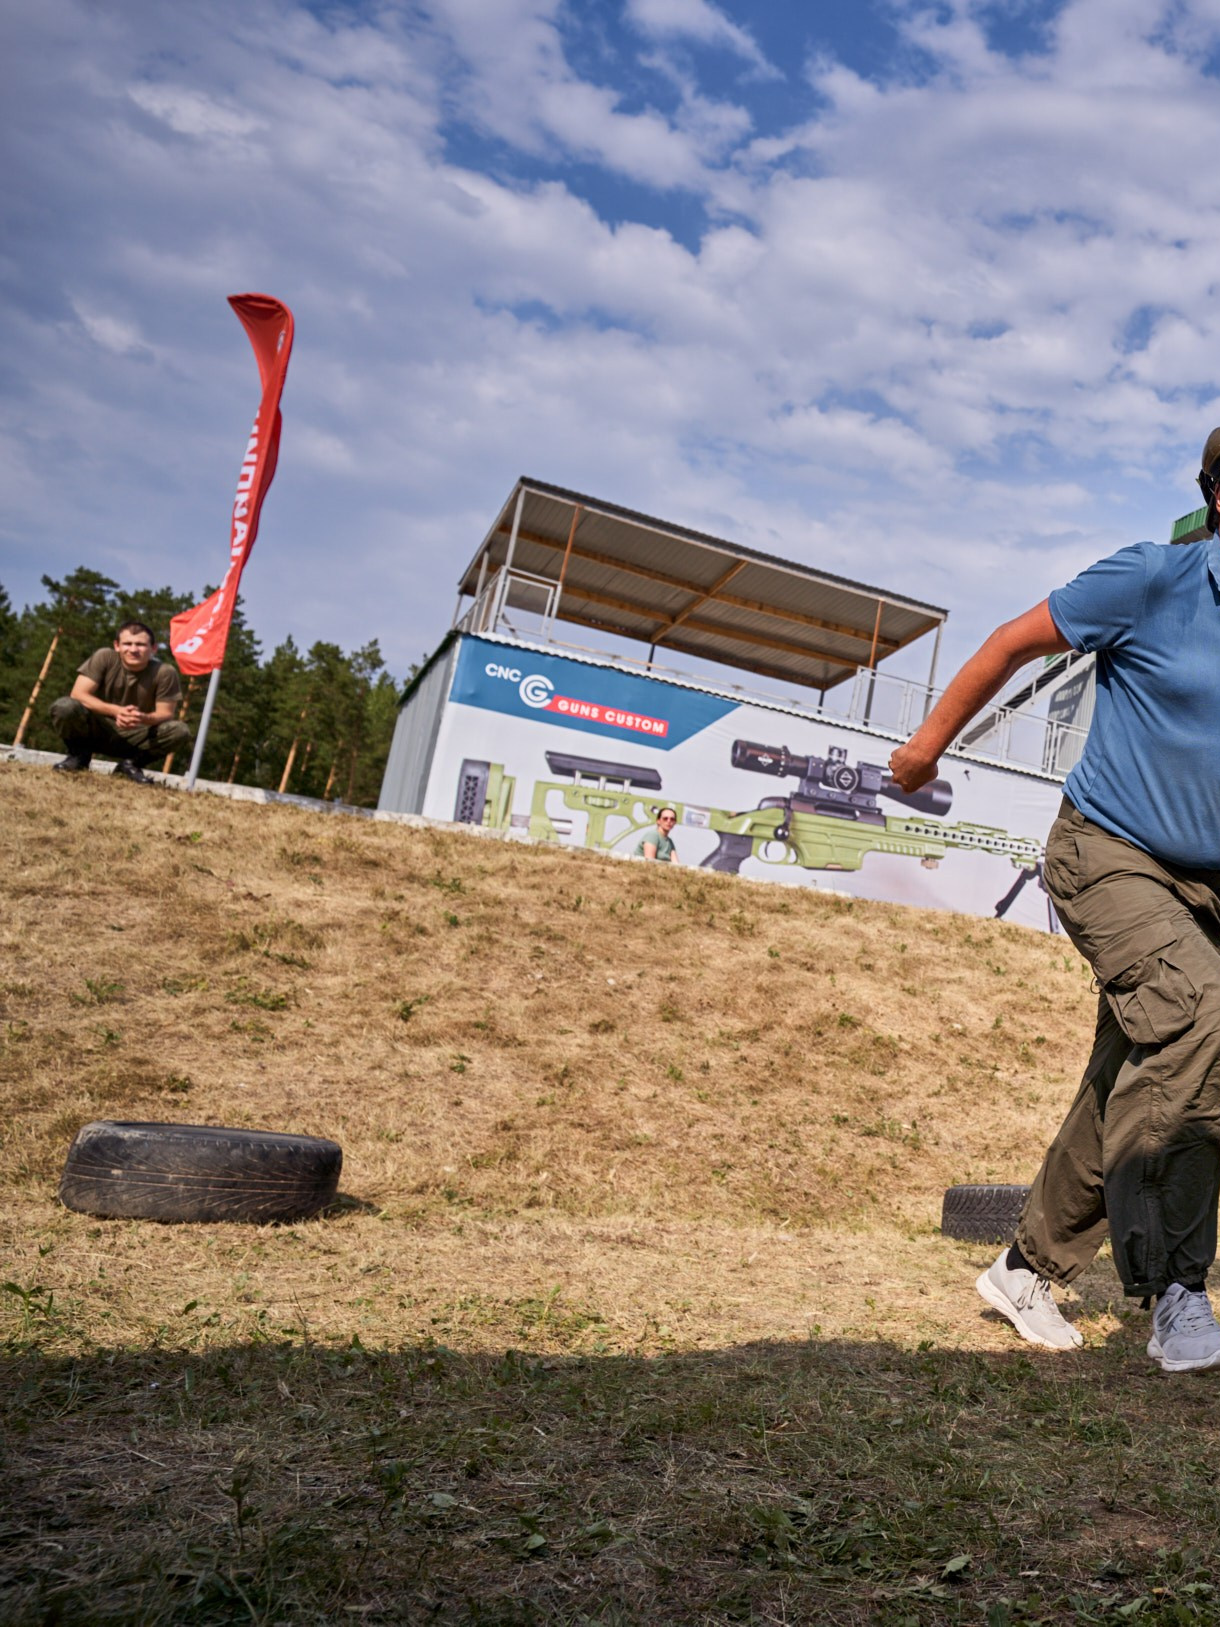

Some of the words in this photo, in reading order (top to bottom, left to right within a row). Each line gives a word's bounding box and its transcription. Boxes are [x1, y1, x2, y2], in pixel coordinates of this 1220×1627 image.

[485, 663, 522, 682] CNC
[557, 700, 600, 718] GUNS
[604, 711, 665, 733] CUSTOM
